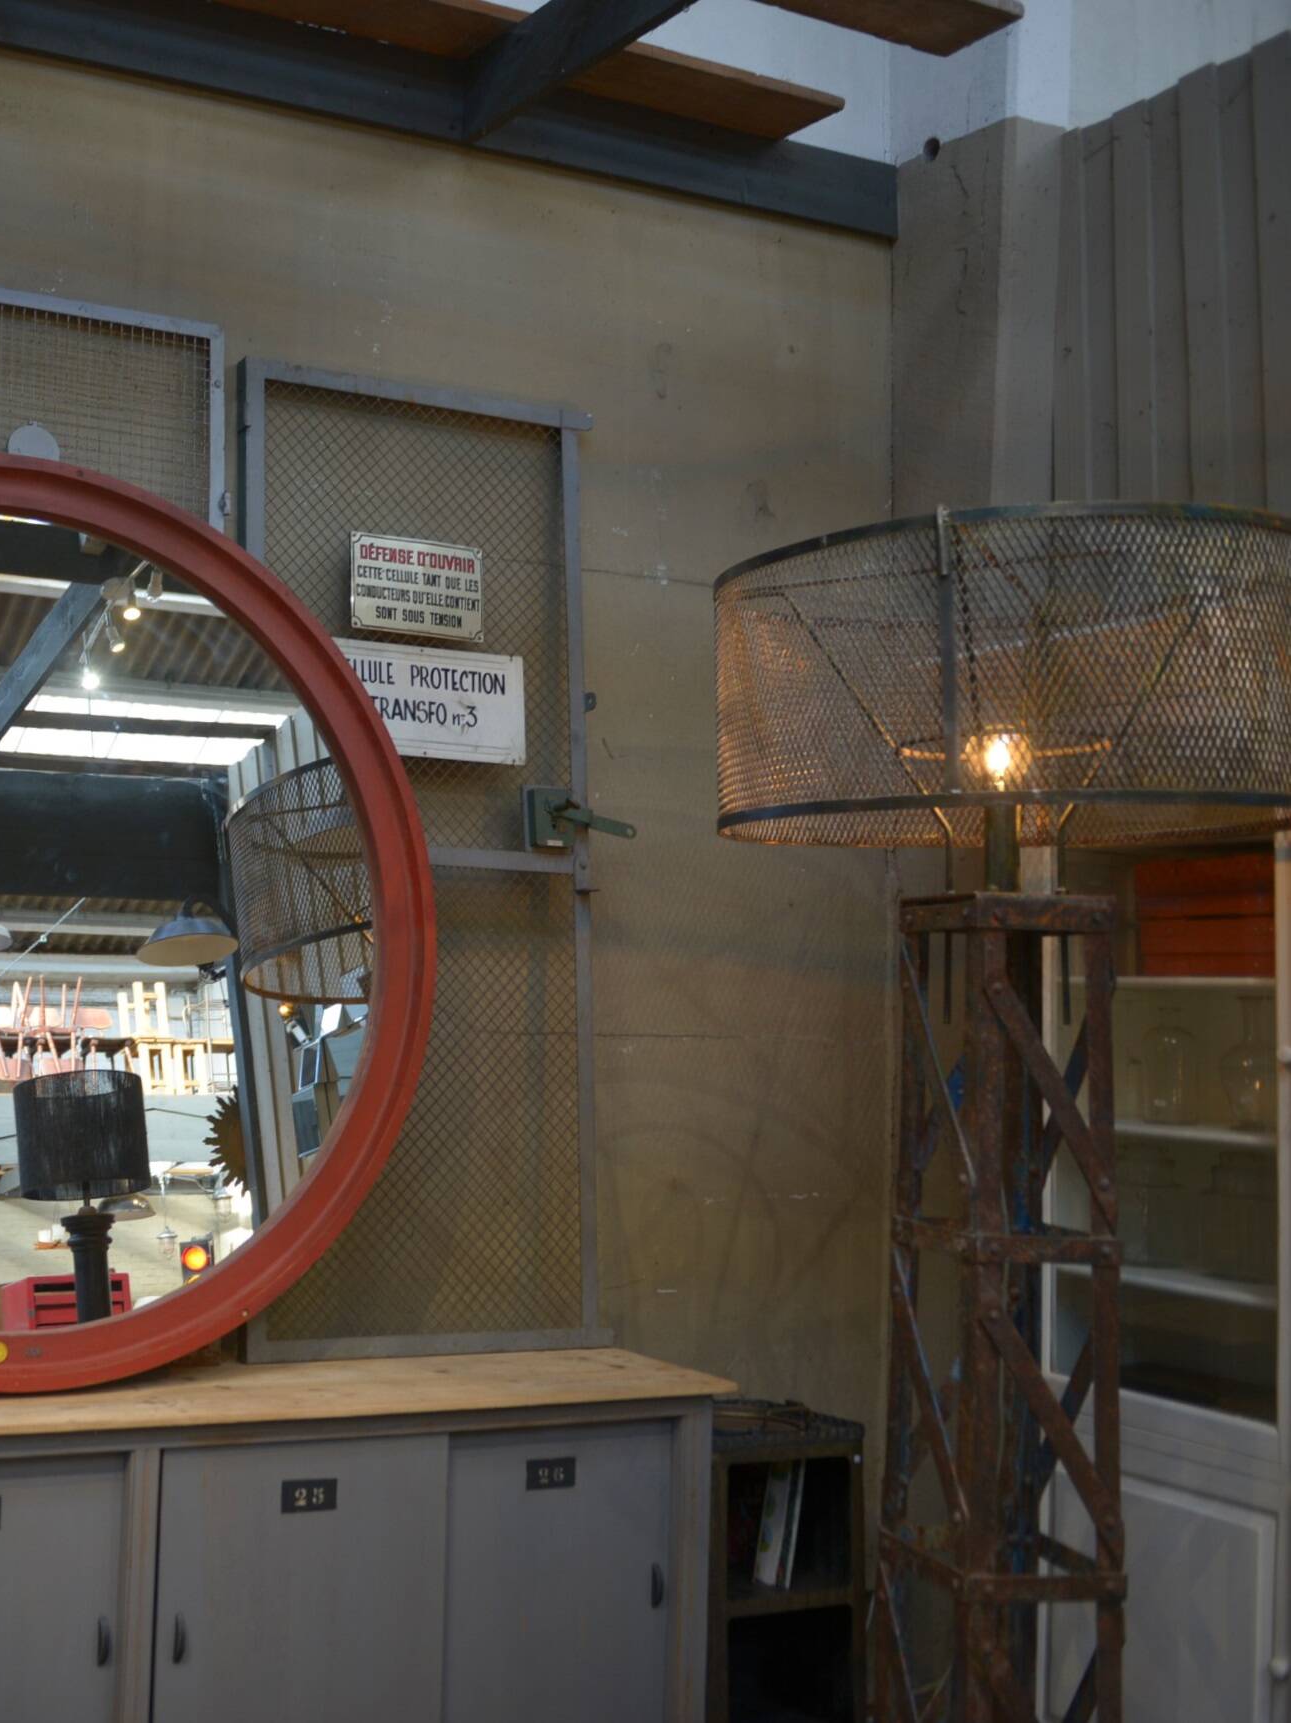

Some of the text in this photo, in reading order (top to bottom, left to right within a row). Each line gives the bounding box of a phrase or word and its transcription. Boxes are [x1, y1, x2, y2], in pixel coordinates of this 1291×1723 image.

[360, 543, 475, 574] DÉFENSE D'OUVRIR
[357, 565, 479, 593] CETTE CELLULE TANT QUE LES
[356, 583, 480, 613] CONDUCTEURS QU'ELLE CONTIENT
[375, 606, 462, 628] SONT SOUS TENSION
[410, 664, 506, 696] PROTECTION
[539, 1467, 564, 1484] 26
[294, 1487, 324, 1506] 25
